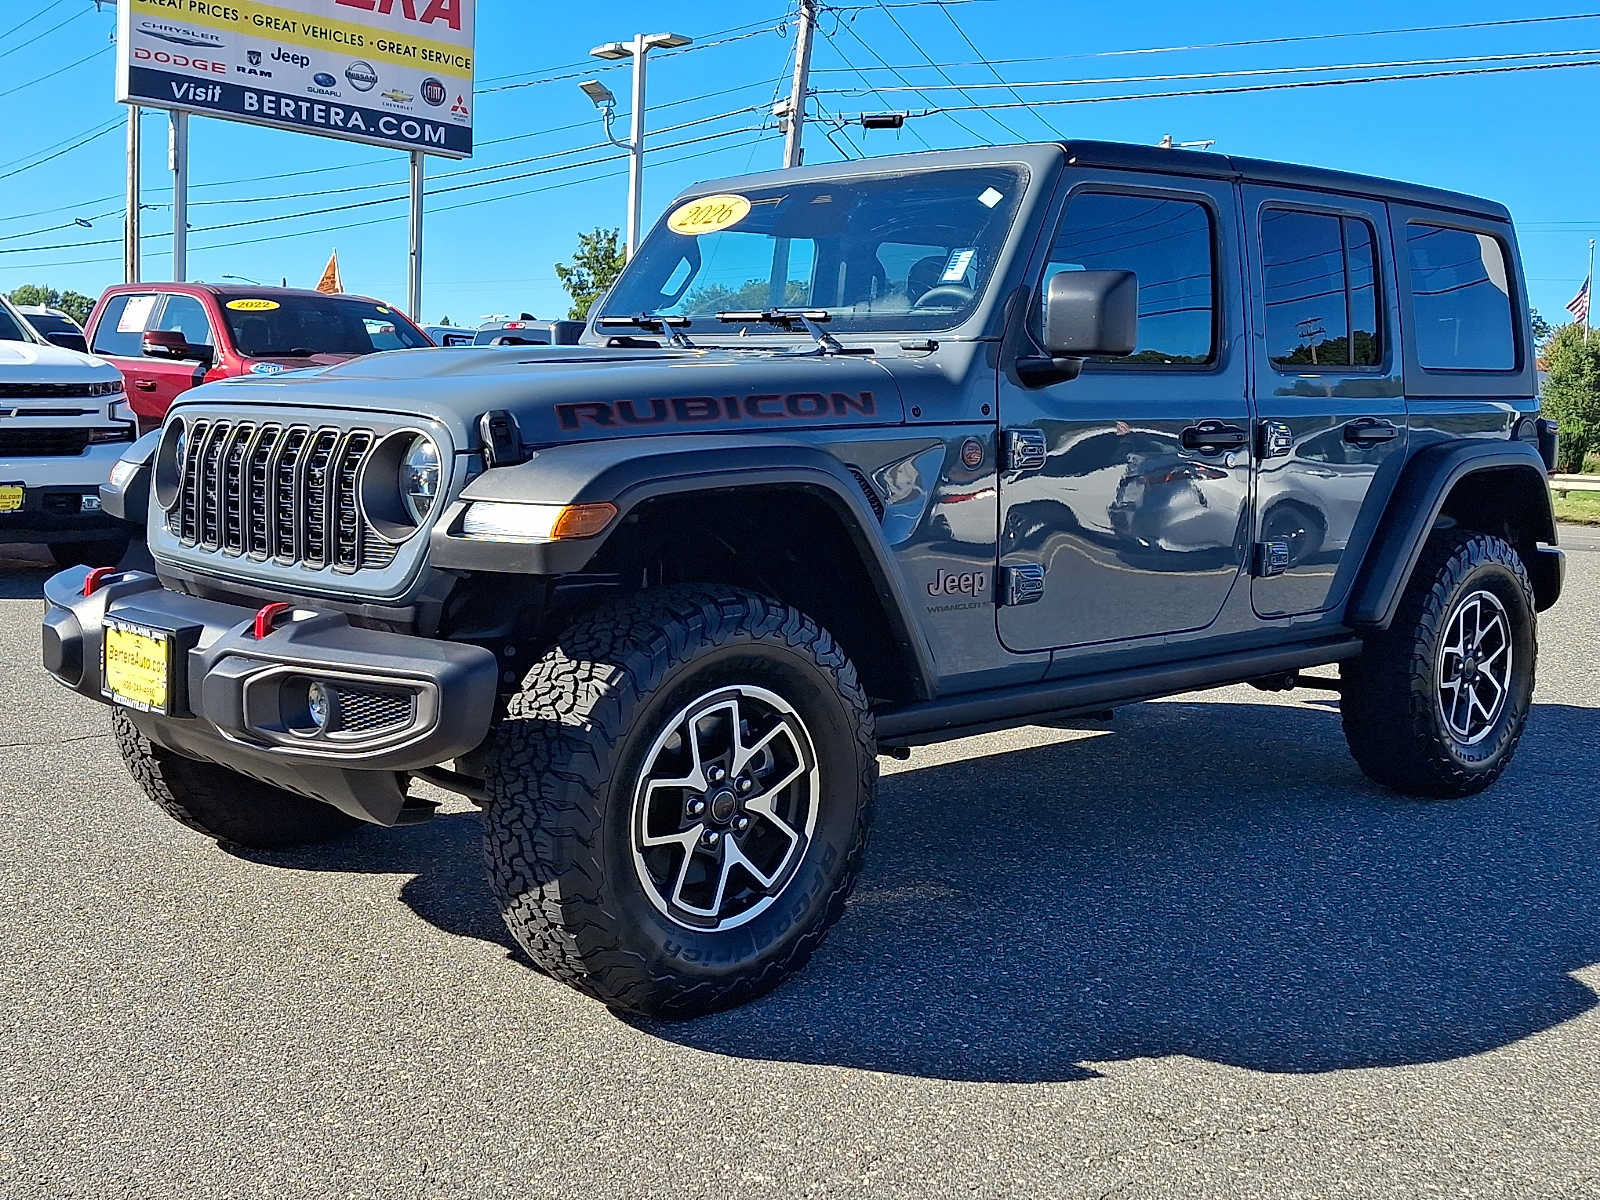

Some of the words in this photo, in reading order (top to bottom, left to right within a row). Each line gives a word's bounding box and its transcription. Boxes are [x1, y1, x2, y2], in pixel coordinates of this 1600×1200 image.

[141, 21, 220, 42] CHRYSLER
[189, 0, 239, 21] PRICES
[252, 14, 298, 33] GREAT
[301, 23, 364, 47] VEHICLES
[376, 39, 418, 58] GREAT
[421, 48, 471, 70] SERVICE
[134, 47, 226, 74] DODGE
[270, 47, 310, 69] Jeep
[236, 65, 272, 78] RAM
[347, 71, 377, 83] NISSAN
[307, 86, 342, 98] SUBARU
[426, 85, 442, 101] FIAT
[171, 81, 222, 103] Visit
[243, 91, 445, 145] BERTERA.COM
[677, 200, 742, 228] 2026
[236, 301, 271, 309] 2022
[553, 390, 878, 431] RUBICON
[926, 567, 986, 598] Jeep
